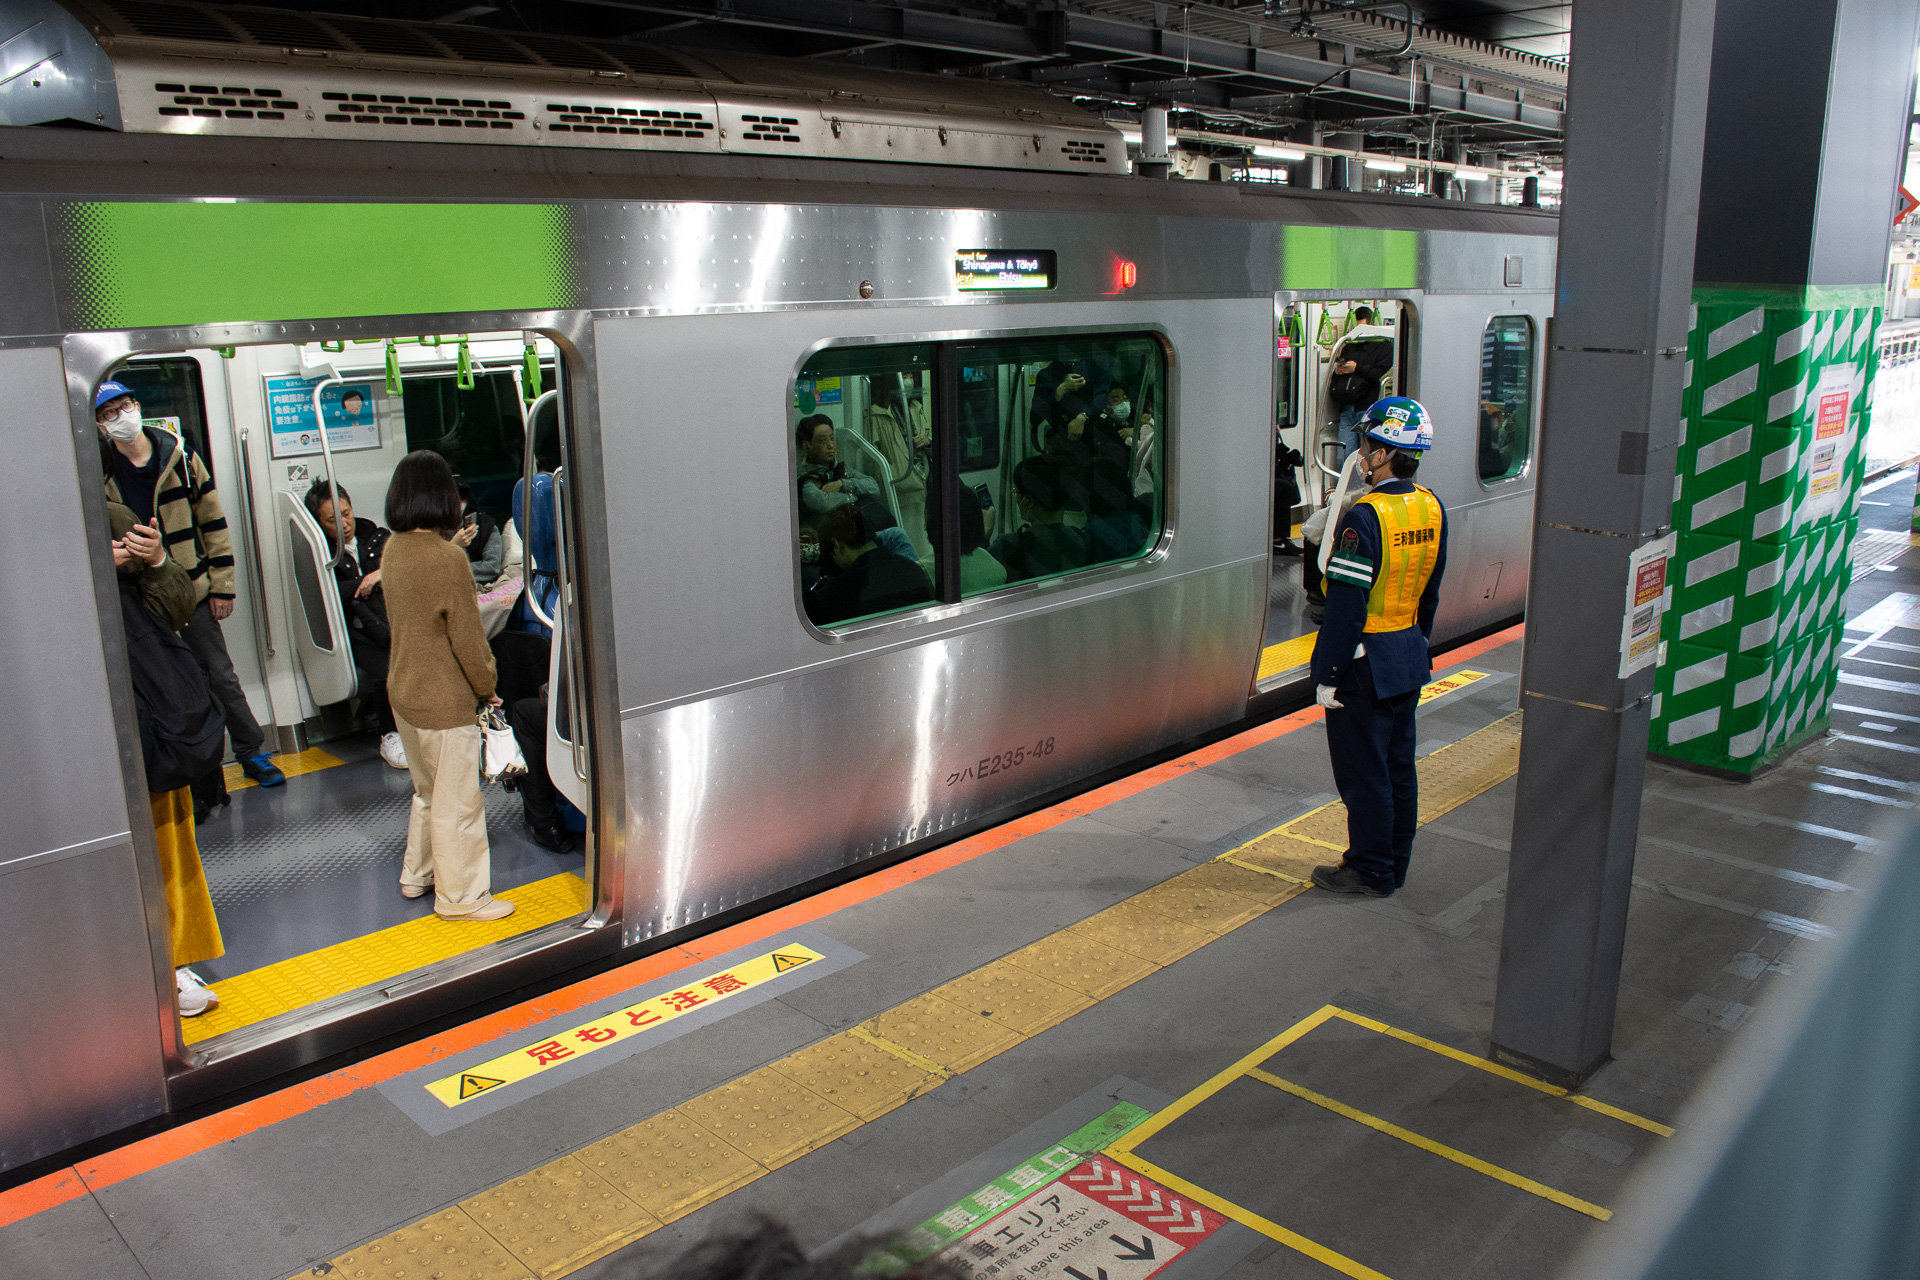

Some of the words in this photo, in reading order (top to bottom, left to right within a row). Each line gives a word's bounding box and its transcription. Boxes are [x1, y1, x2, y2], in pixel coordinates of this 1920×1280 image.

[976, 251, 987, 261] for
[963, 260, 1005, 272] Shinagawa
[1007, 260, 1014, 270] &
[1393, 528, 1435, 547] 三和警備保障
[526, 974, 748, 1066] 足もと注意
[1024, 1252, 1060, 1275] leave
[1058, 1235, 1083, 1252] this
[1083, 1218, 1110, 1237] area
